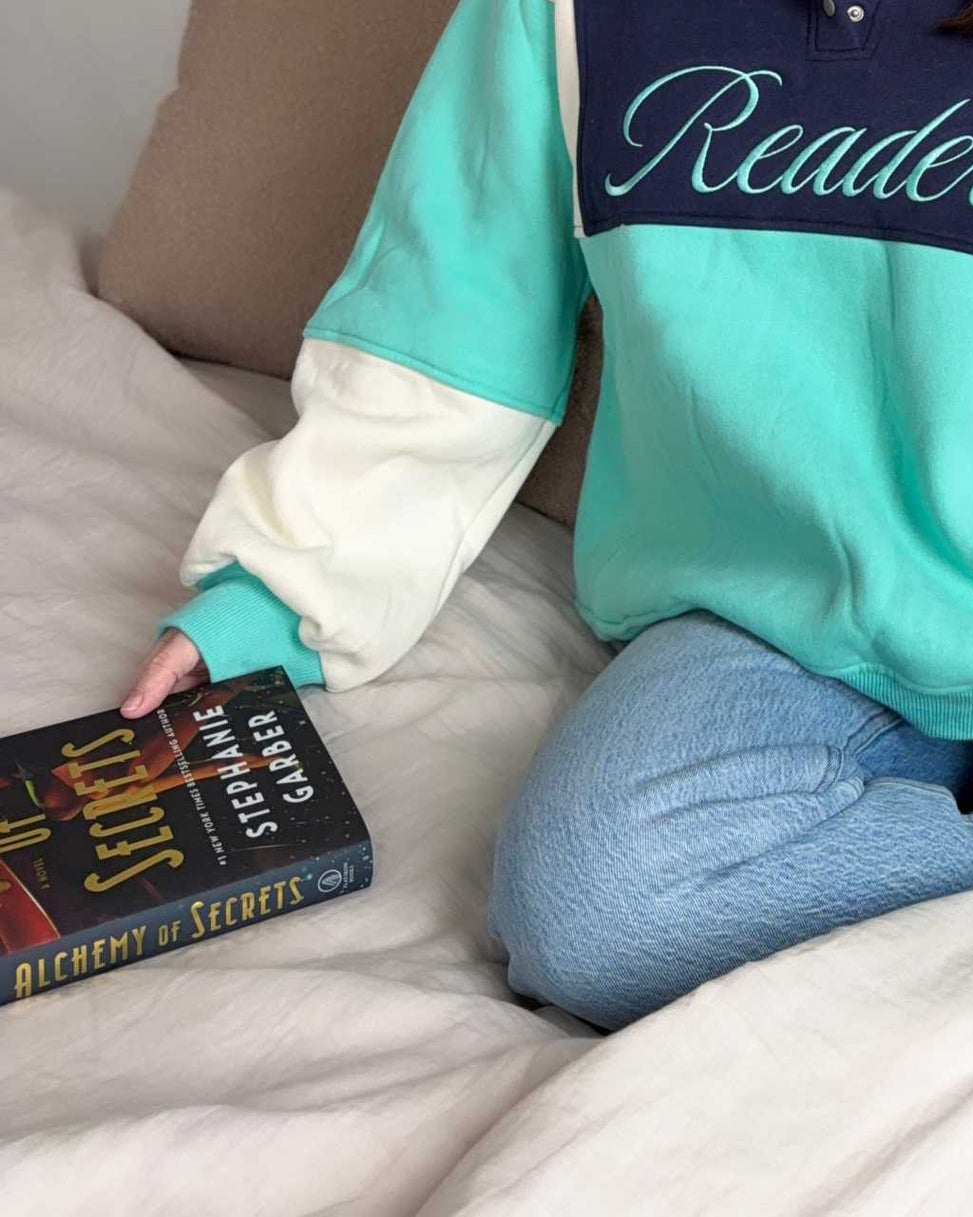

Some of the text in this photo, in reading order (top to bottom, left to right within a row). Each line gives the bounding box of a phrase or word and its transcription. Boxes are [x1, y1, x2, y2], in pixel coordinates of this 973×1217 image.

[156, 708, 175, 740] AUTHOR
[168, 739, 196, 787] BESTSELLING
[193, 705, 278, 838] STEPHANIE
[248, 710, 314, 803] GARBER
[61, 728, 184, 892] SECRETS
[189, 788, 206, 810] TIMES
[199, 811, 216, 834] YORK
[209, 835, 225, 854] NEW
[14, 876, 304, 998] ALCHEMY OF SECRETS
